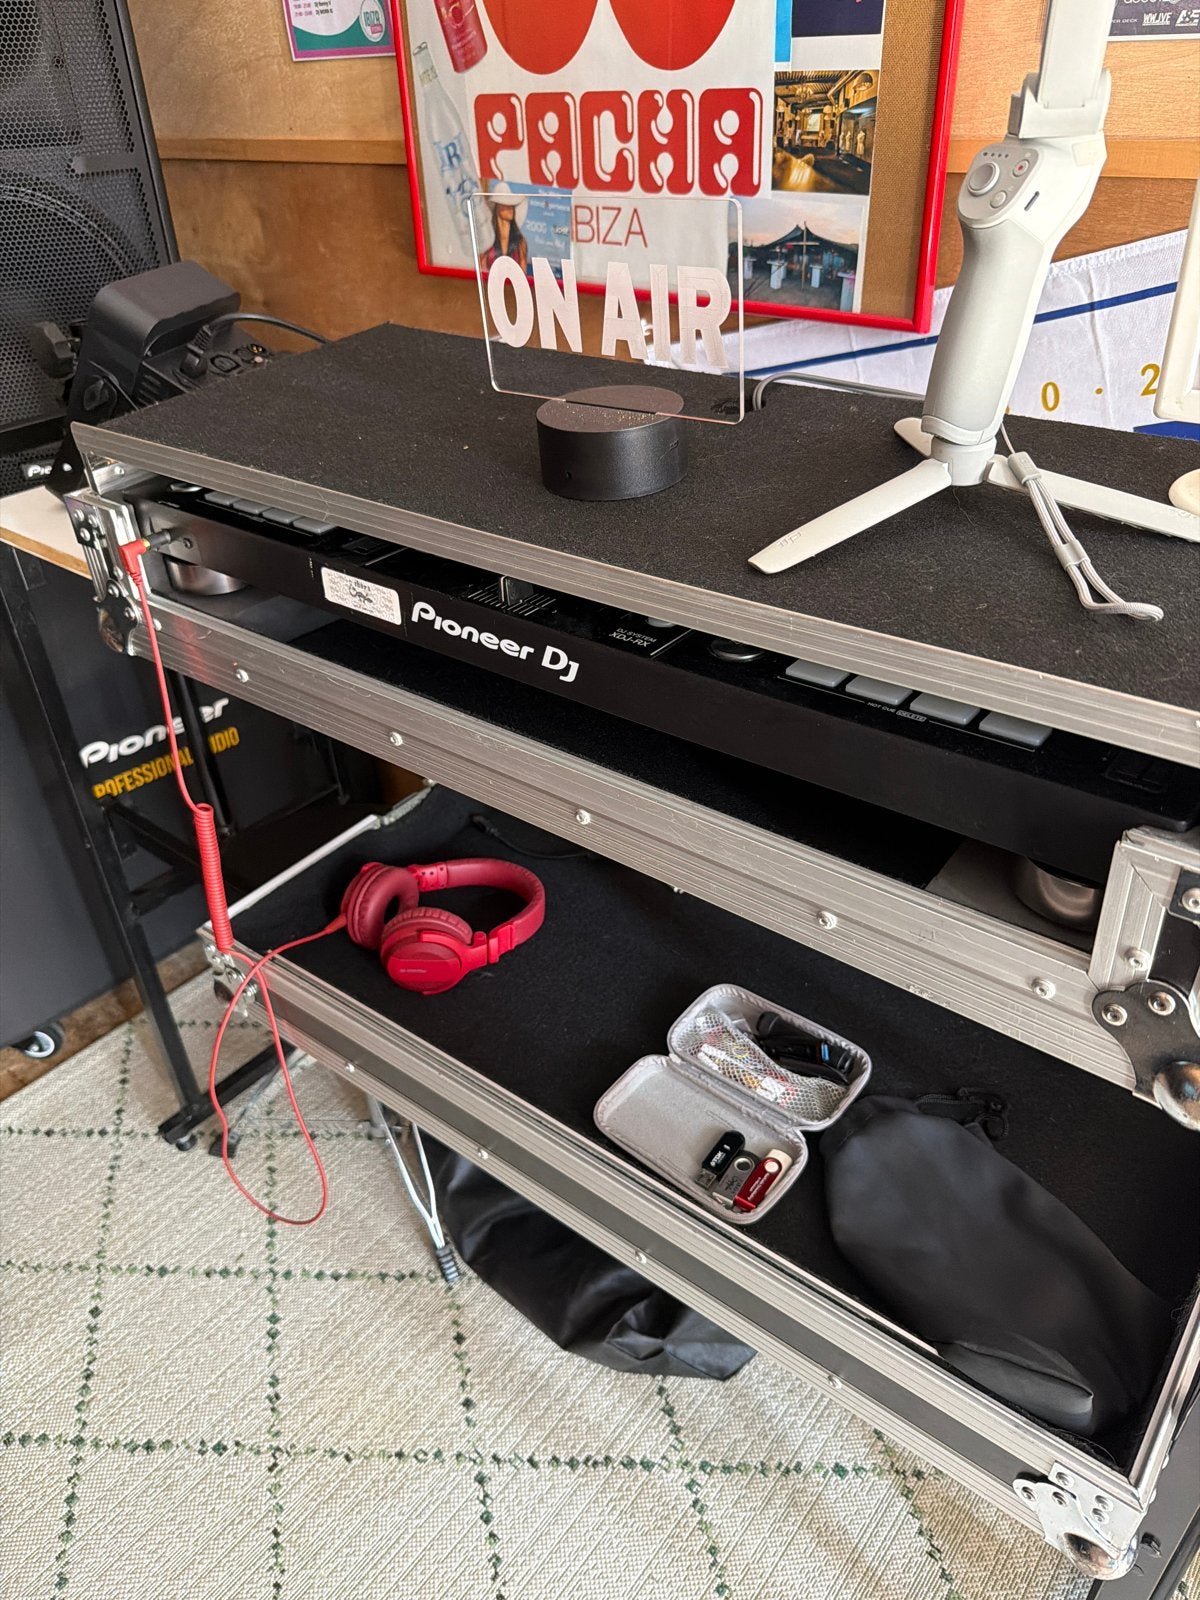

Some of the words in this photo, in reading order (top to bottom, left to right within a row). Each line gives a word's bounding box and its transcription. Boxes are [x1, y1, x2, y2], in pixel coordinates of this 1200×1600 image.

[474, 87, 764, 197] PACHA
[488, 256, 583, 353] ON
[601, 261, 732, 369] AIR
[411, 601, 535, 660] Pioneer
[608, 631, 651, 647] XDJ-RX
[626, 631, 657, 643] SYSTEM
